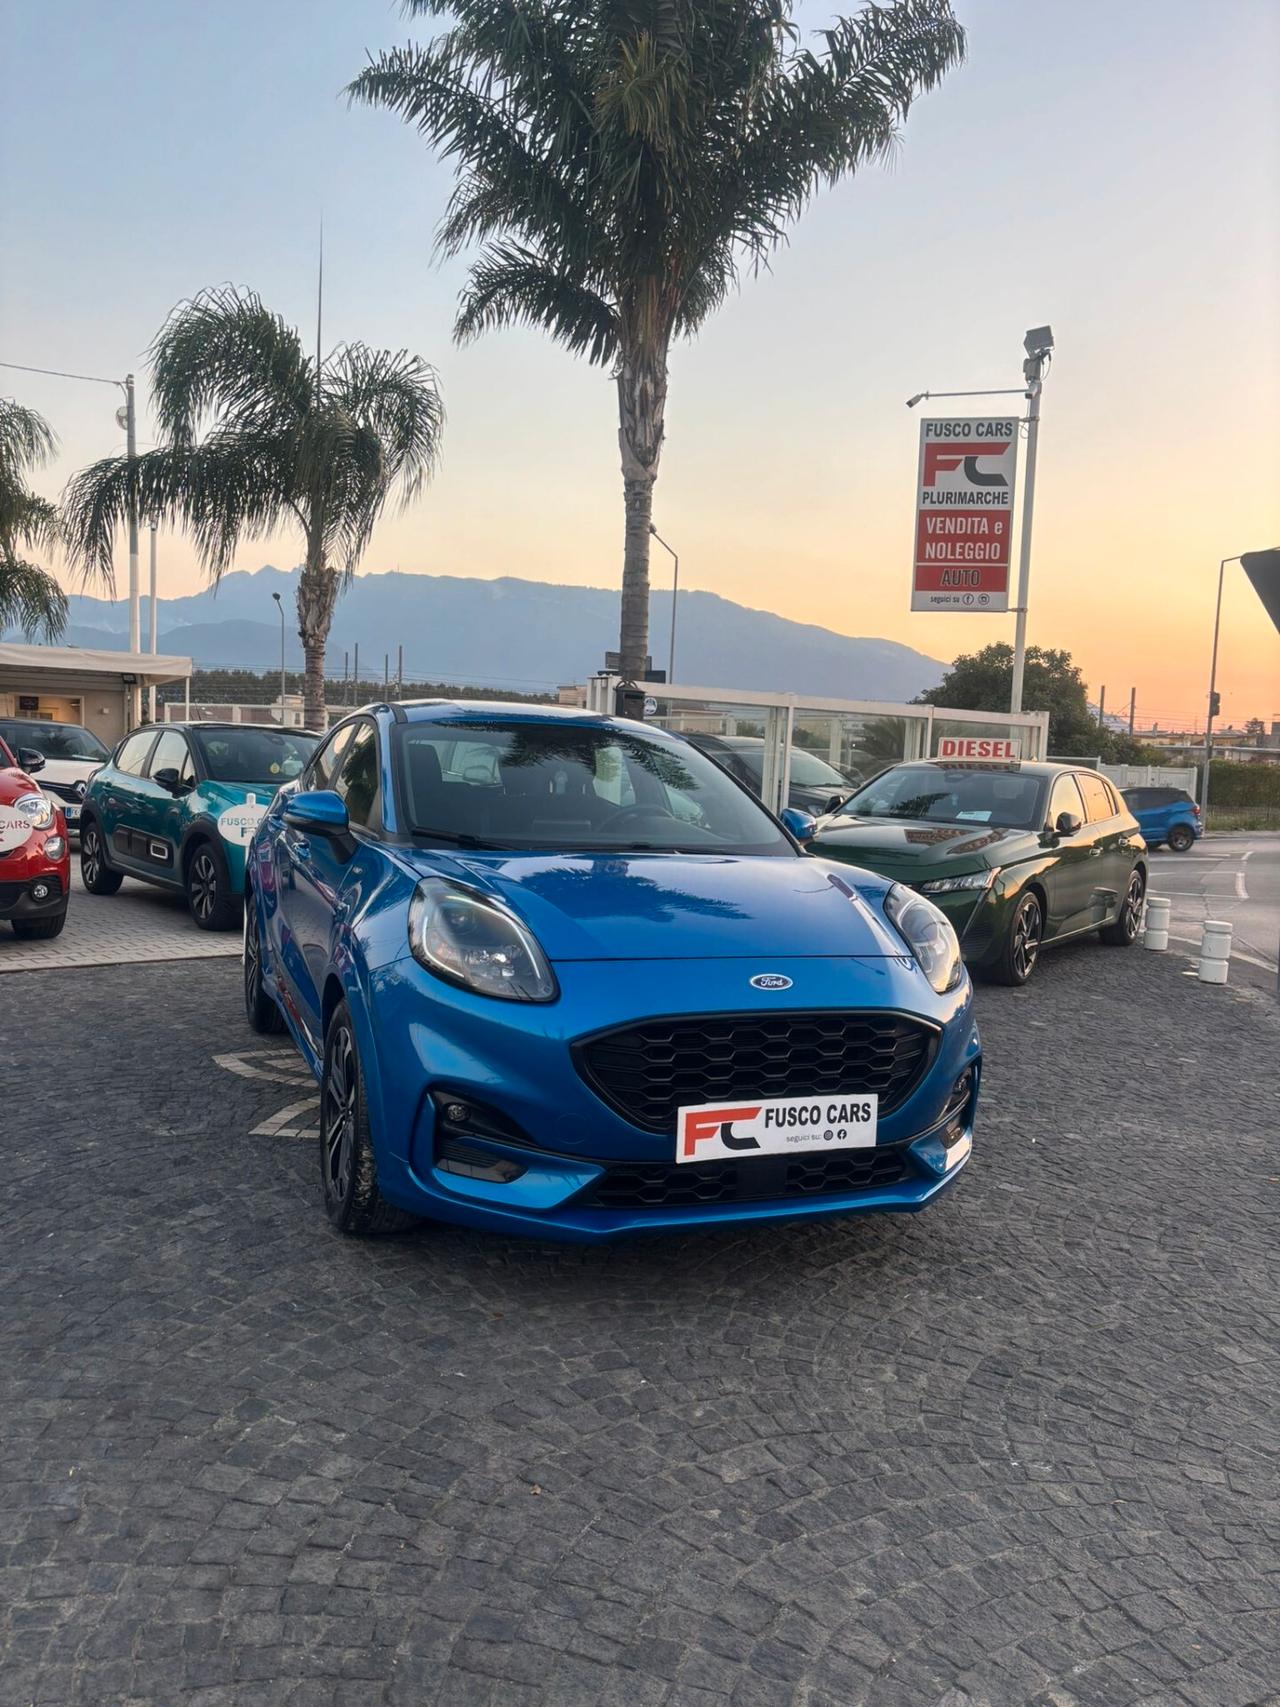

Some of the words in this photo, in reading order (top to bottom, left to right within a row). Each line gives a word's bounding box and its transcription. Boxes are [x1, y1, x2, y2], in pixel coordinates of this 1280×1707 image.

[925, 422, 971, 438] FUSCO
[975, 422, 1013, 437] CARS
[923, 442, 1011, 487] FC
[922, 491, 1009, 505] PLURIMARCHE
[926, 517, 989, 534] VENDITA
[994, 521, 1003, 535] e
[925, 542, 1000, 560] NOLEGGIO
[941, 569, 980, 586] AUTO
[942, 740, 1016, 758] DIESEL
[0, 820, 31, 829] CARS
[220, 817, 255, 826] FUSCO
[760, 976, 784, 987] Ford
[765, 1105, 821, 1128] FUSCO
[826, 1102, 871, 1124] CARS
[684, 1106, 763, 1156] FC
